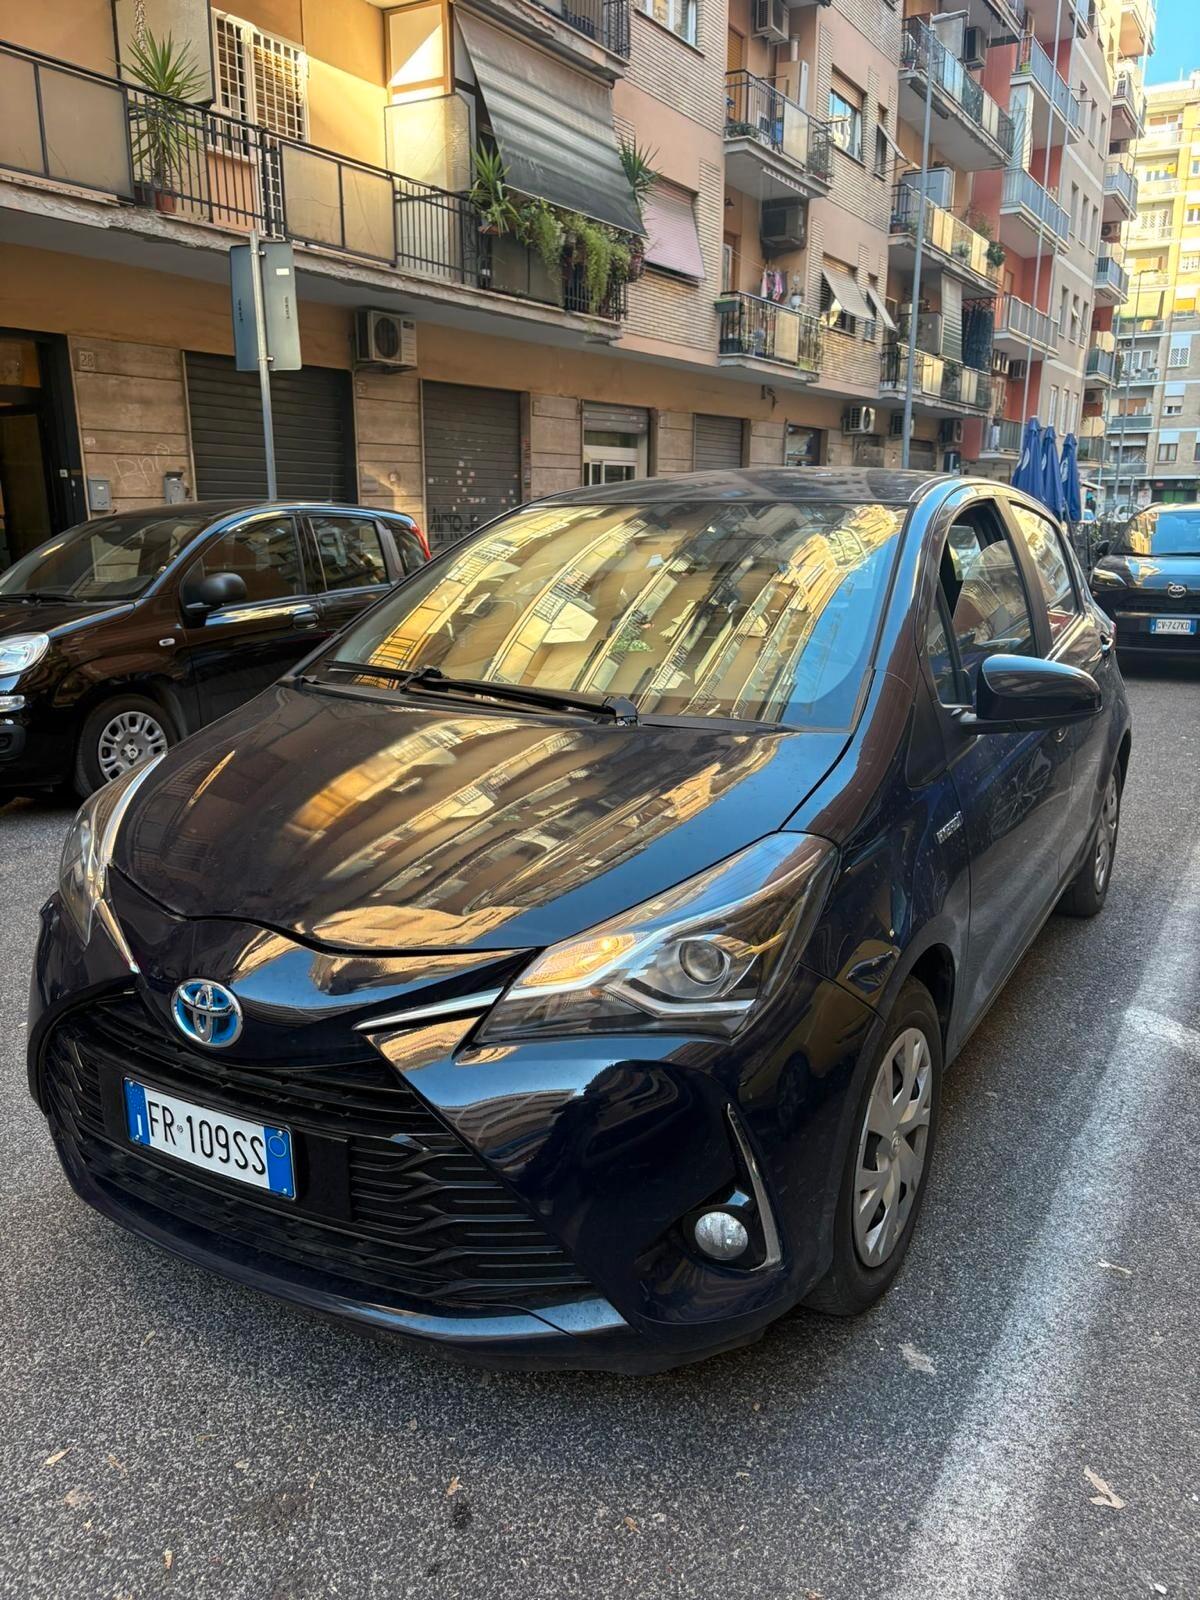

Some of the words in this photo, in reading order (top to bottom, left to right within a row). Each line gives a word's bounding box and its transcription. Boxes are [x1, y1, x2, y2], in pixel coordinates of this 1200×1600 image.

[80, 352, 94, 368] 28
[147, 1100, 177, 1146] FR
[186, 1115, 266, 1176] 109SS
